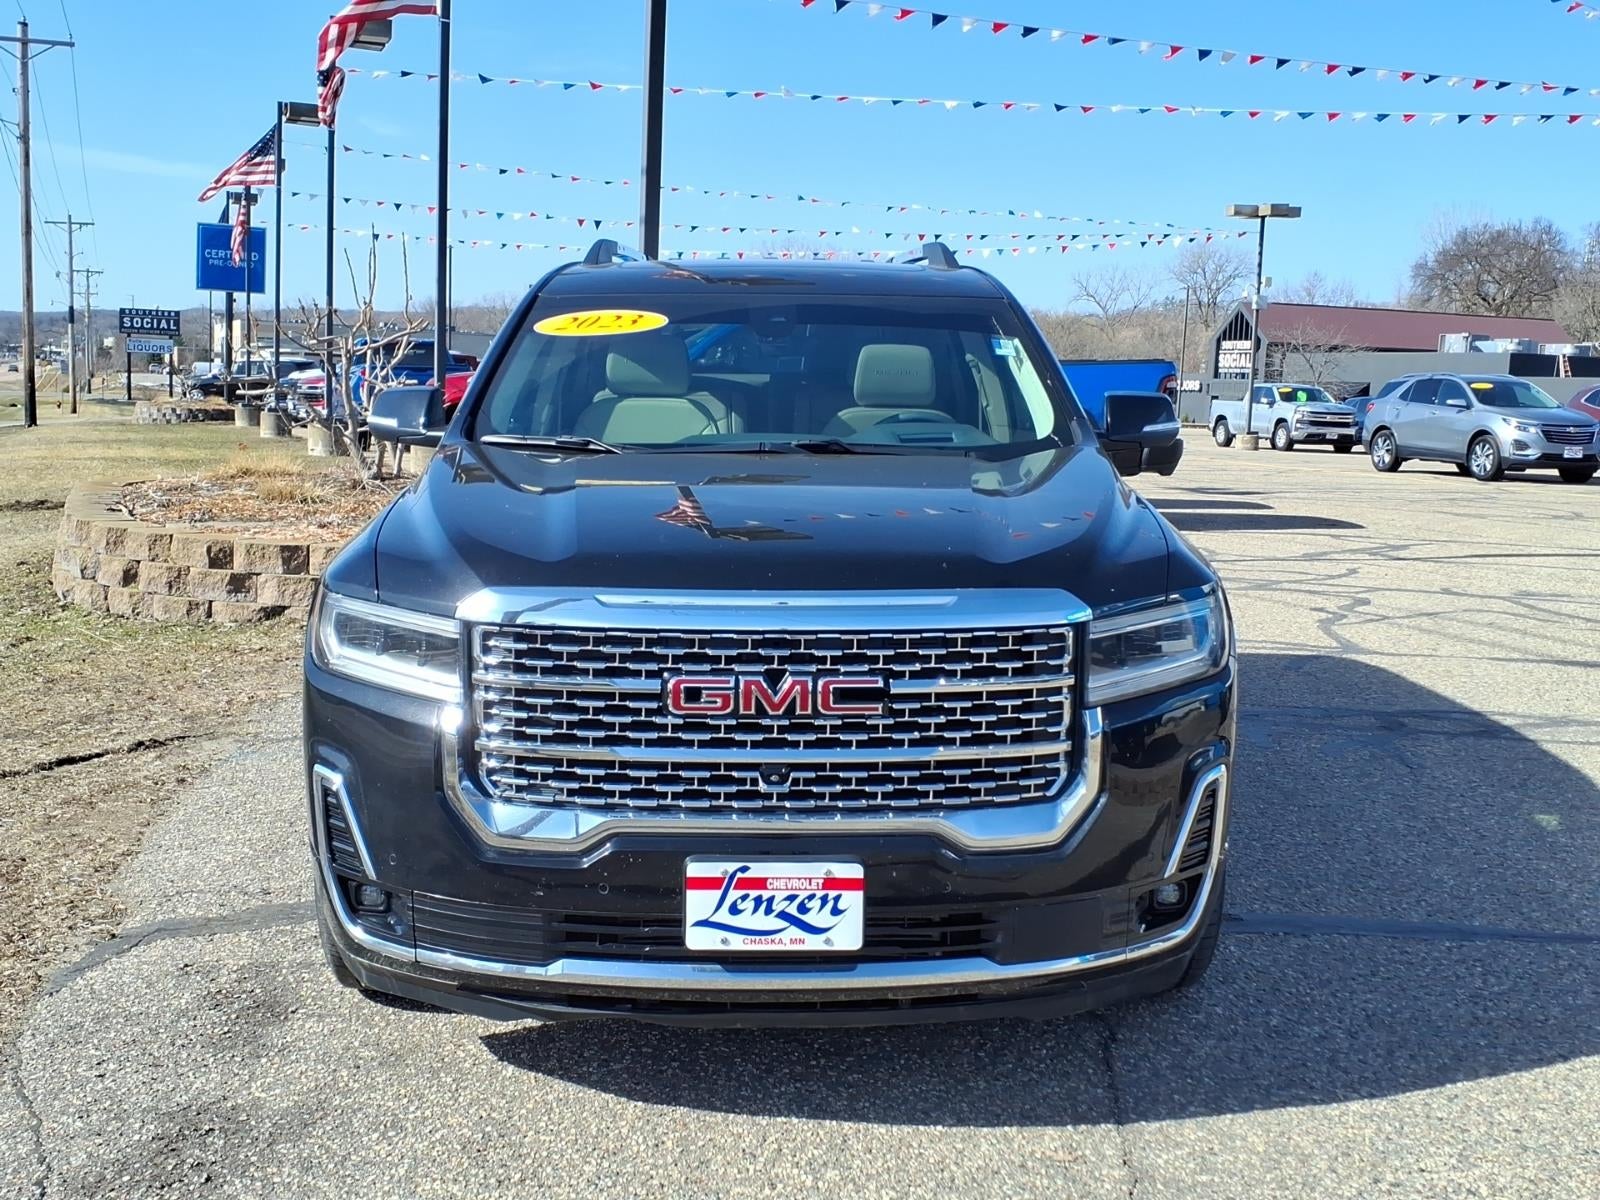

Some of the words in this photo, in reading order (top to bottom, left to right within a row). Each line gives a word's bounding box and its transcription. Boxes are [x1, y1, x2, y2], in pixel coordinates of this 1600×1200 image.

[205, 249, 259, 261] CERTD
[123, 317, 177, 330] SOCIAL
[127, 343, 173, 353] LIQUORS
[1218, 353, 1252, 368] SOCIAL
[668, 674, 884, 715] GMC
[766, 878, 824, 890] CHEVROLET
[690, 865, 851, 936] Lenzen
[742, 937, 787, 946] CHASKA,
[789, 937, 806, 945] MN
